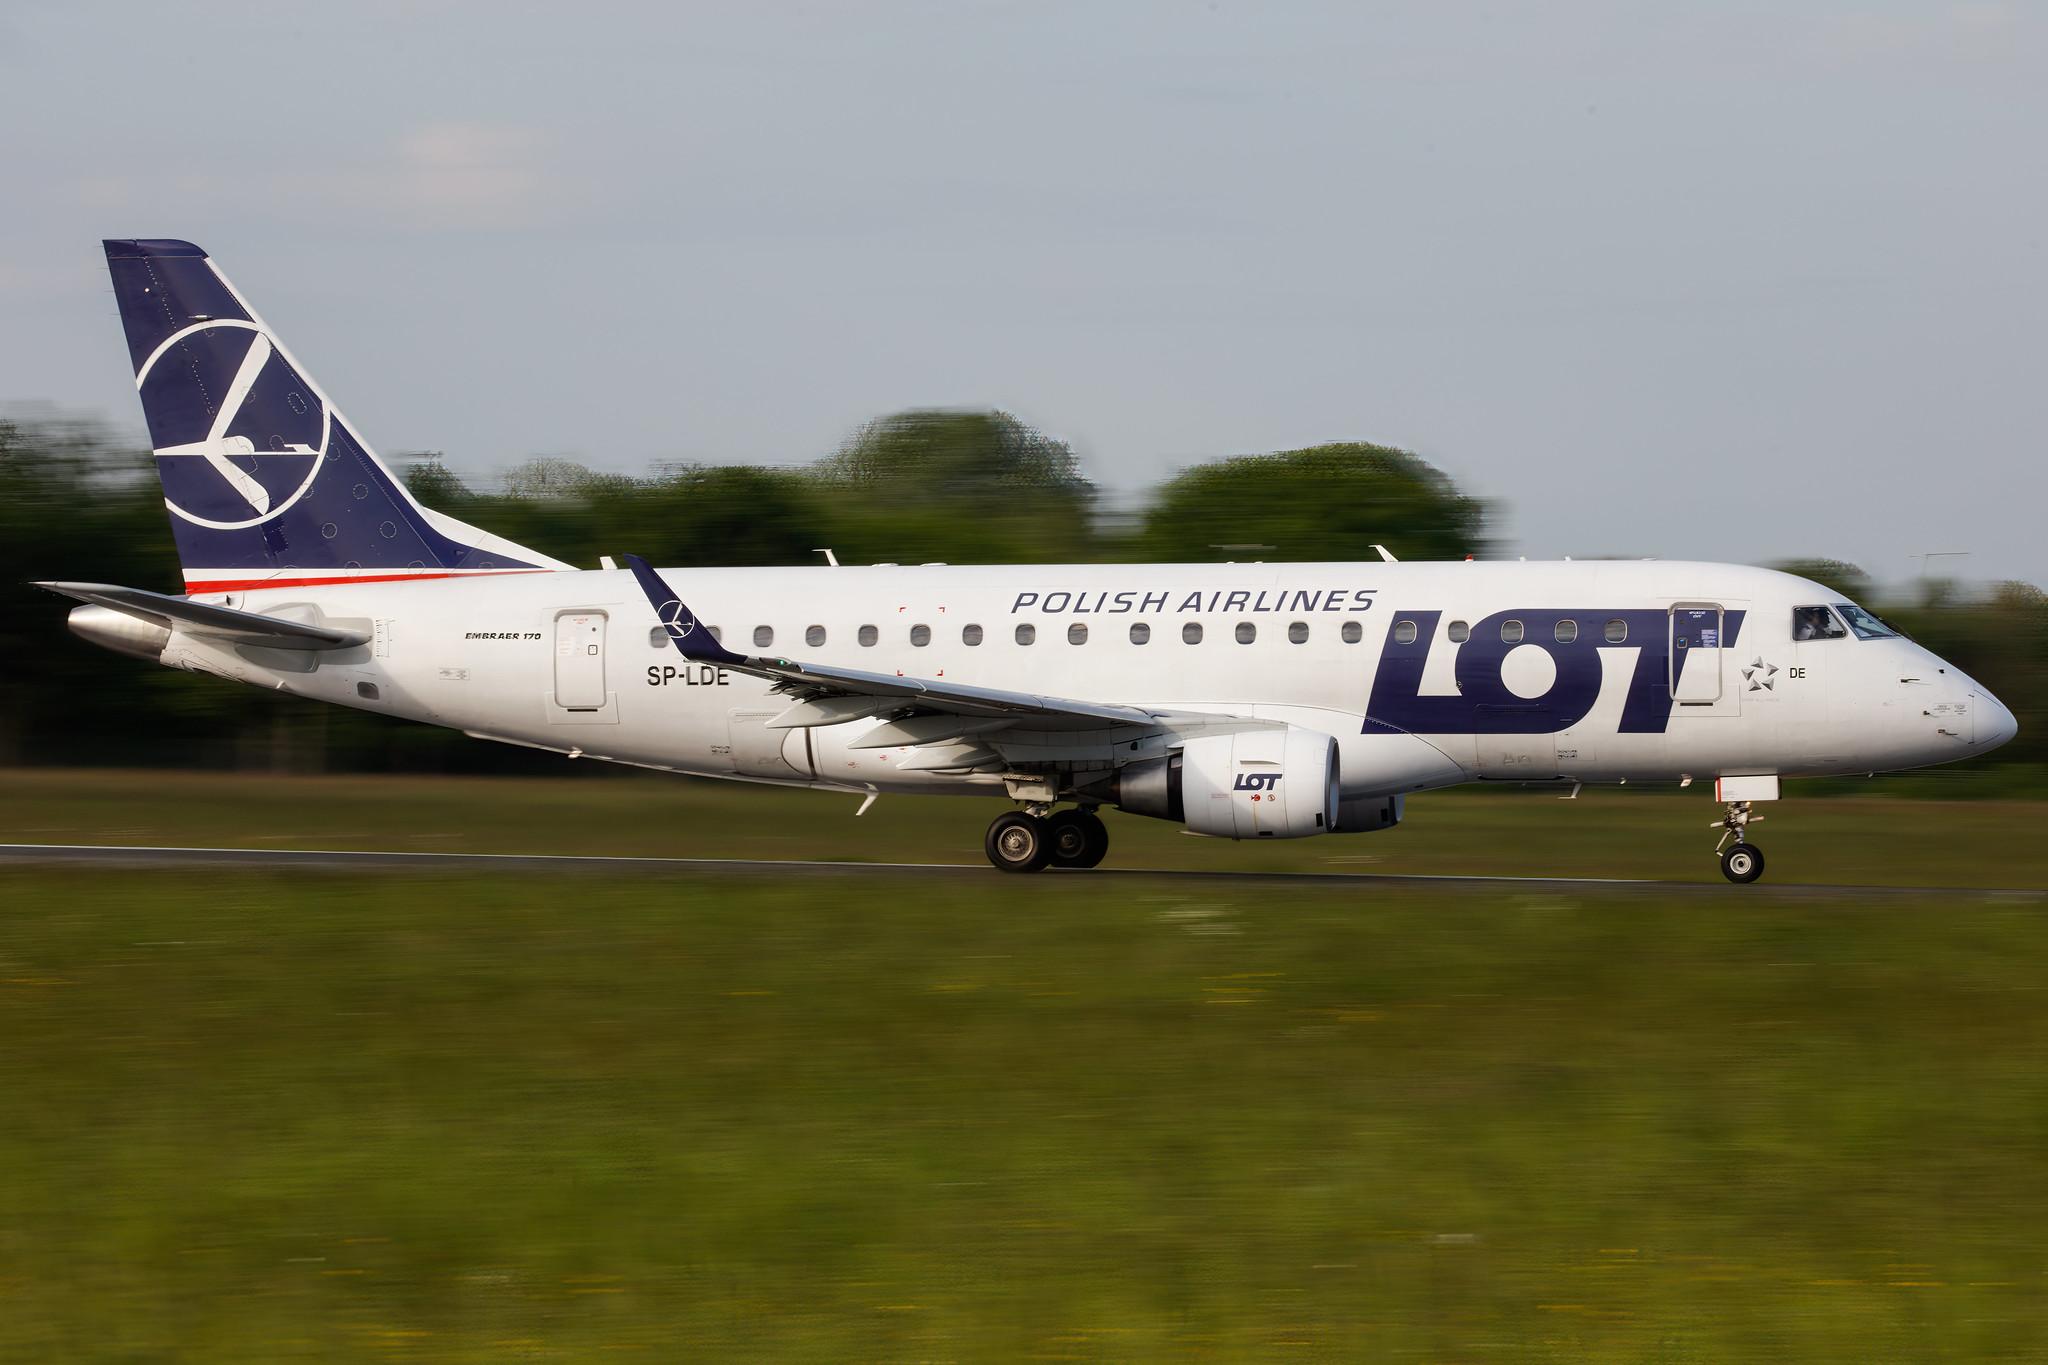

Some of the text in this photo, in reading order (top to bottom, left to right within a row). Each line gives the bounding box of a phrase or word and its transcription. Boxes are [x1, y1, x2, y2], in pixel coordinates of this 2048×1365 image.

[1011, 590, 1378, 614] POLISH AIRLINES
[465, 632, 542, 640] EMBRAER 170
[647, 665, 729, 686] SP-LDE
[1361, 608, 1747, 735] LOT
[1789, 667, 1806, 679] DE
[1233, 773, 1283, 791] LOT
